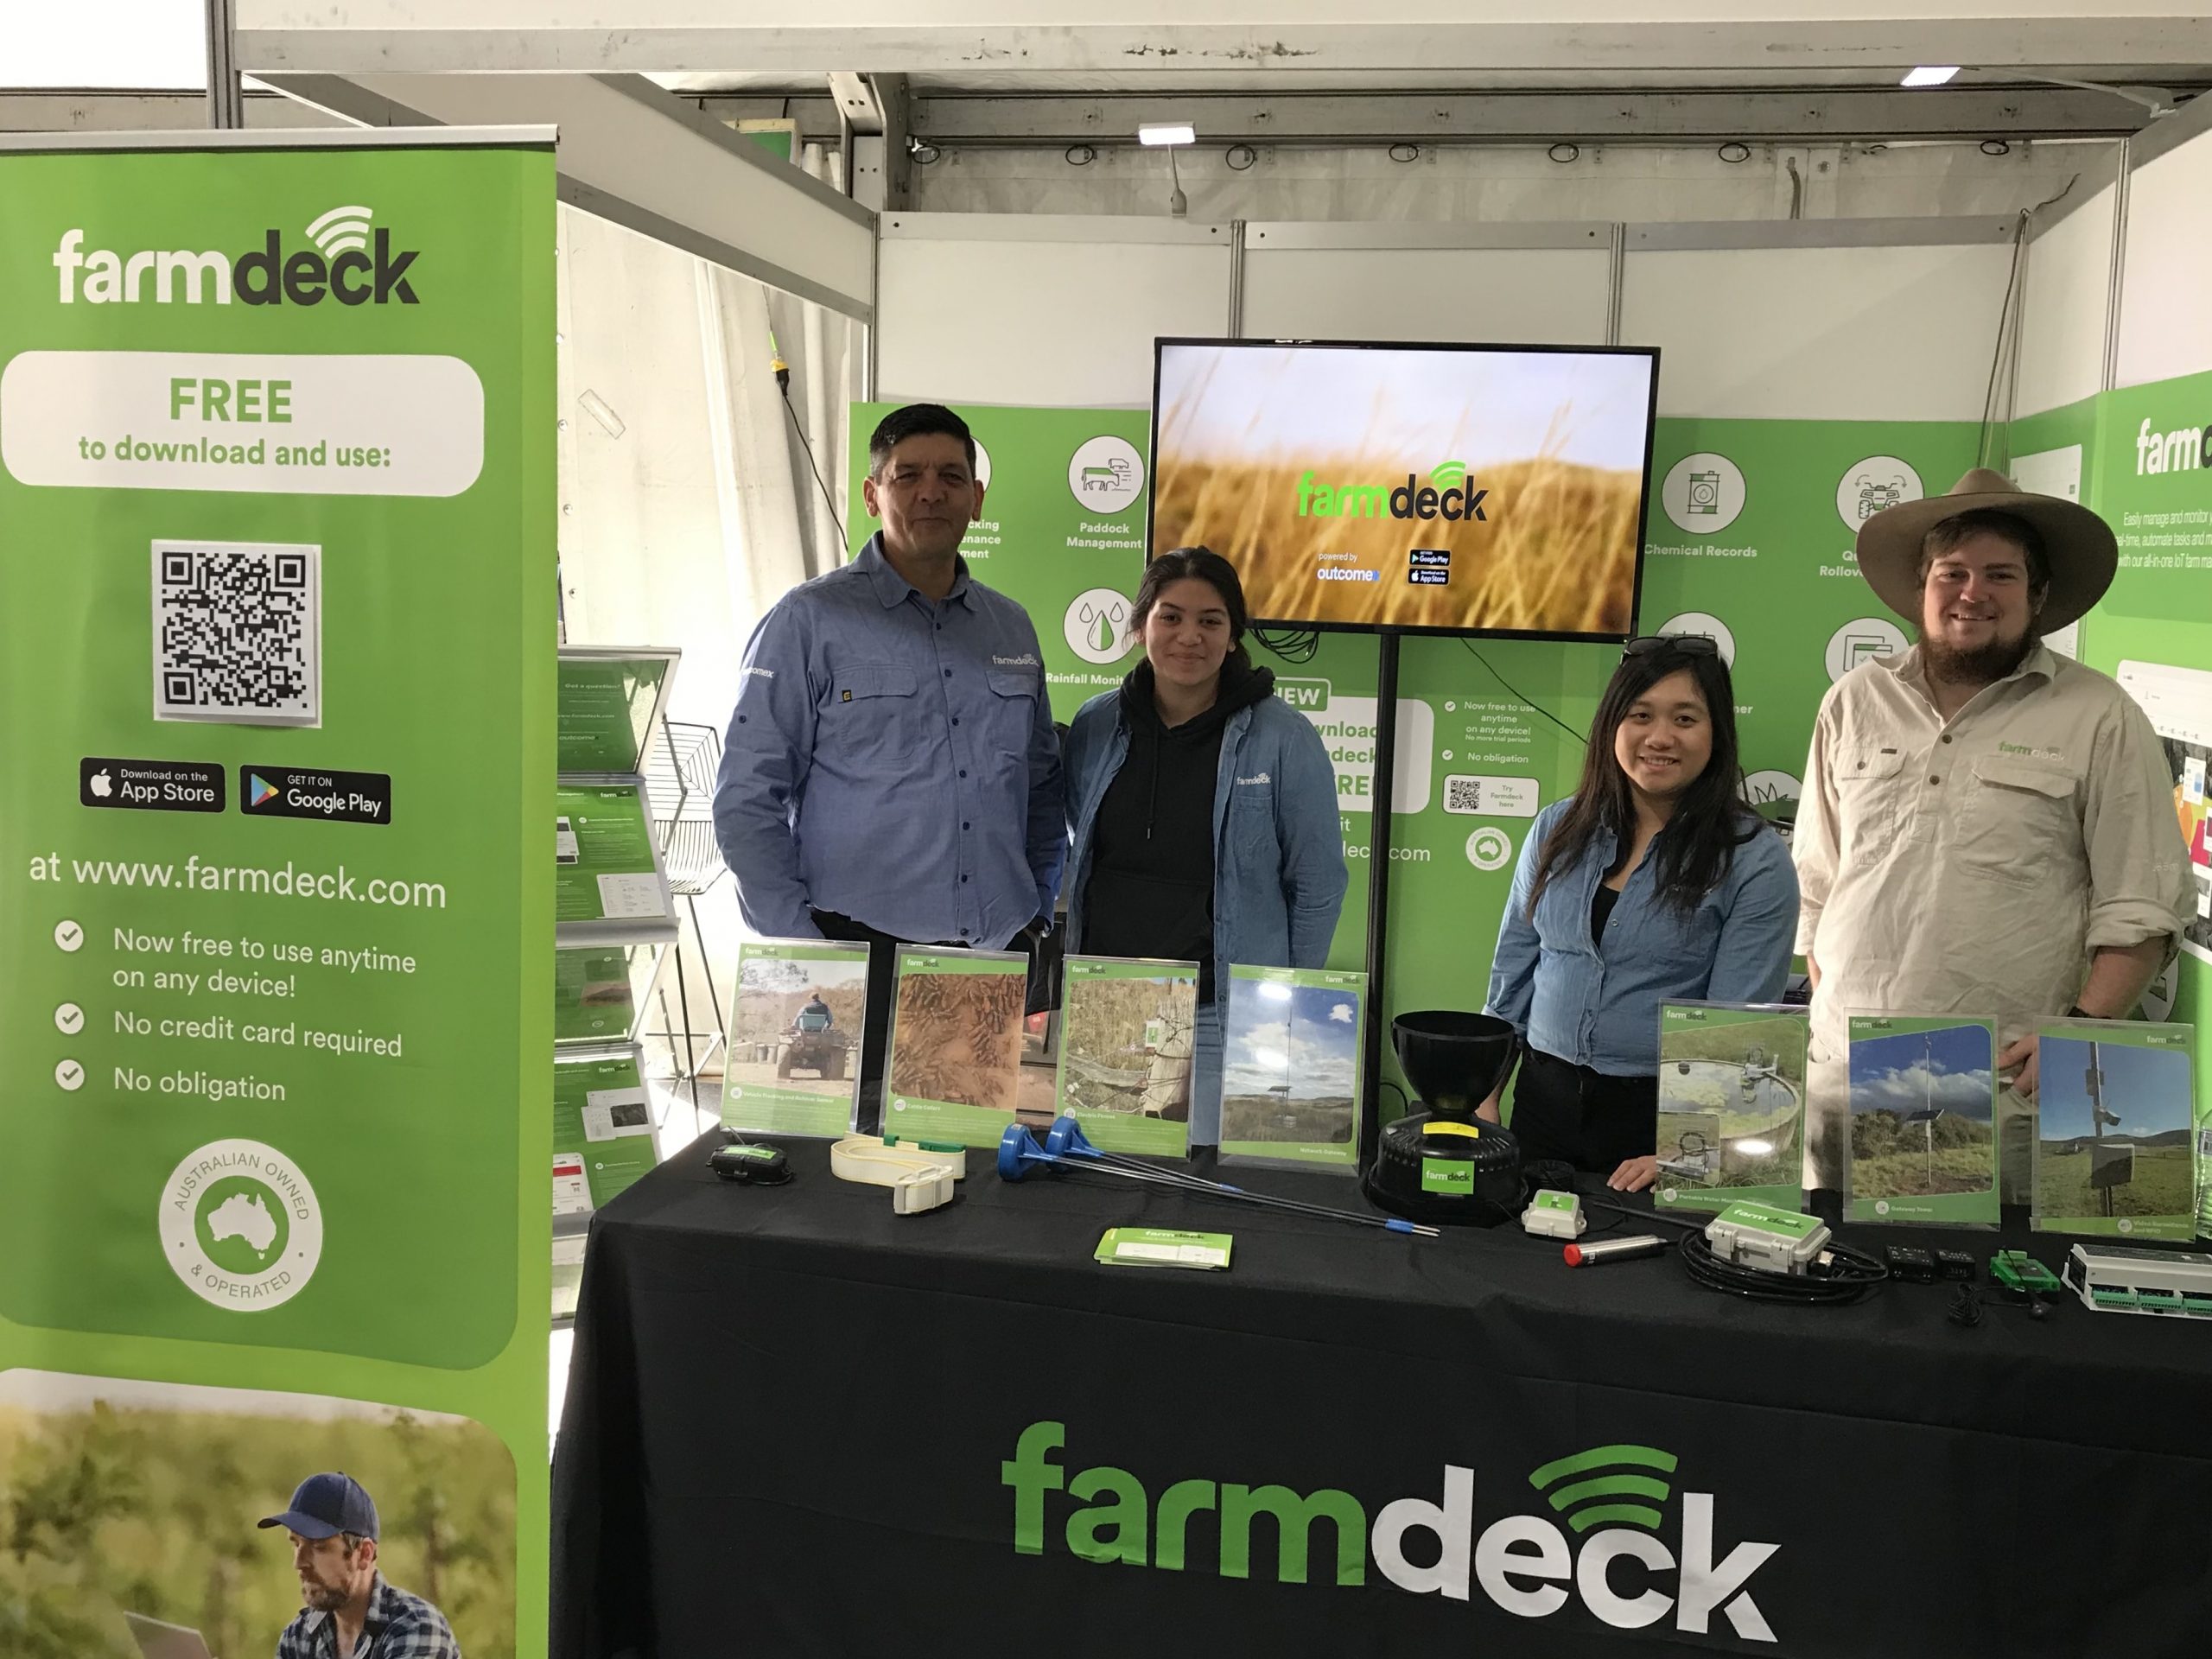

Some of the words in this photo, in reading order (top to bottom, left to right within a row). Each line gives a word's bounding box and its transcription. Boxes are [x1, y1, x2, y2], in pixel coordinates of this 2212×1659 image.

[53, 227, 421, 306] farmdeck
[170, 378, 293, 423] FREE
[79, 436, 106, 461] to
[115, 435, 265, 465] download
[275, 440, 327, 467] and
[335, 447, 391, 467] use:
[1298, 470, 1488, 521] farmdeck
[2124, 512, 2142, 529] Easily
[2143, 513, 2170, 528] manage
[2171, 510, 2183, 524] and
[2183, 509, 2209, 524] monitor
[1080, 522, 1129, 534] Paddock
[1066, 536, 1142, 550] Management
[2142, 532, 2173, 546] automate
[2174, 531, 2191, 546] tasks
[2191, 531, 2205, 546] and
[1319, 552, 1349, 562] powered
[1350, 552, 1358, 562] by
[1644, 543, 1703, 556] Chemical
[1706, 545, 1758, 557] Records
[1437, 556, 1449, 564] Play
[2132, 556, 2143, 568] our
[2144, 554, 2173, 568] all-in-one
[2175, 553, 2185, 568] IoT
[2185, 553, 2201, 568] farm
[1046, 672, 1088, 684] Rainfall
[1465, 702, 1486, 710] Now
[1488, 702, 1506, 711] free
[1481, 715, 1518, 724] anytime
[1479, 727, 1497, 735] any
[1498, 726, 1531, 735] device!
[1468, 753, 1482, 761] No
[1484, 753, 1529, 764] obligation
[121, 769, 171, 780] Download
[175, 772, 190, 782] on
[191, 771, 209, 783] the
[287, 775, 307, 786] GET
[307, 776, 316, 787] IT
[317, 777, 333, 788] ON
[120, 783, 160, 804] App
[163, 784, 215, 804] Store
[287, 788, 346, 814] Google
[348, 793, 383, 817] Play
[29, 852, 60, 882] at
[72, 855, 447, 909] www.farmdeck.com
[114, 928, 174, 954] Now
[181, 931, 233, 957] free
[240, 936, 265, 959] to
[272, 944, 314, 963] use
[321, 944, 417, 975] anytime
[112, 969, 146, 988] on
[153, 972, 200, 996] any
[207, 968, 296, 998] device!
[1667, 1010, 1707, 1021] farmdeck
[1853, 1020, 1892, 1029] farmdeck
[114, 1011, 152, 1035] No
[160, 1014, 235, 1041] credit
[242, 1021, 296, 1046] card
[303, 1026, 403, 1058] required
[114, 1067, 152, 1091] No
[160, 1069, 286, 1102] obligation
[1427, 1170, 1470, 1182] farmdeck
[174, 1152, 261, 1211] AUSTRALIAN
[264, 1162, 309, 1222] OWNED
[189, 1264, 204, 1278] &
[205, 1269, 293, 1299] OPERATED
[1001, 1421, 1782, 1643] farmdeck
